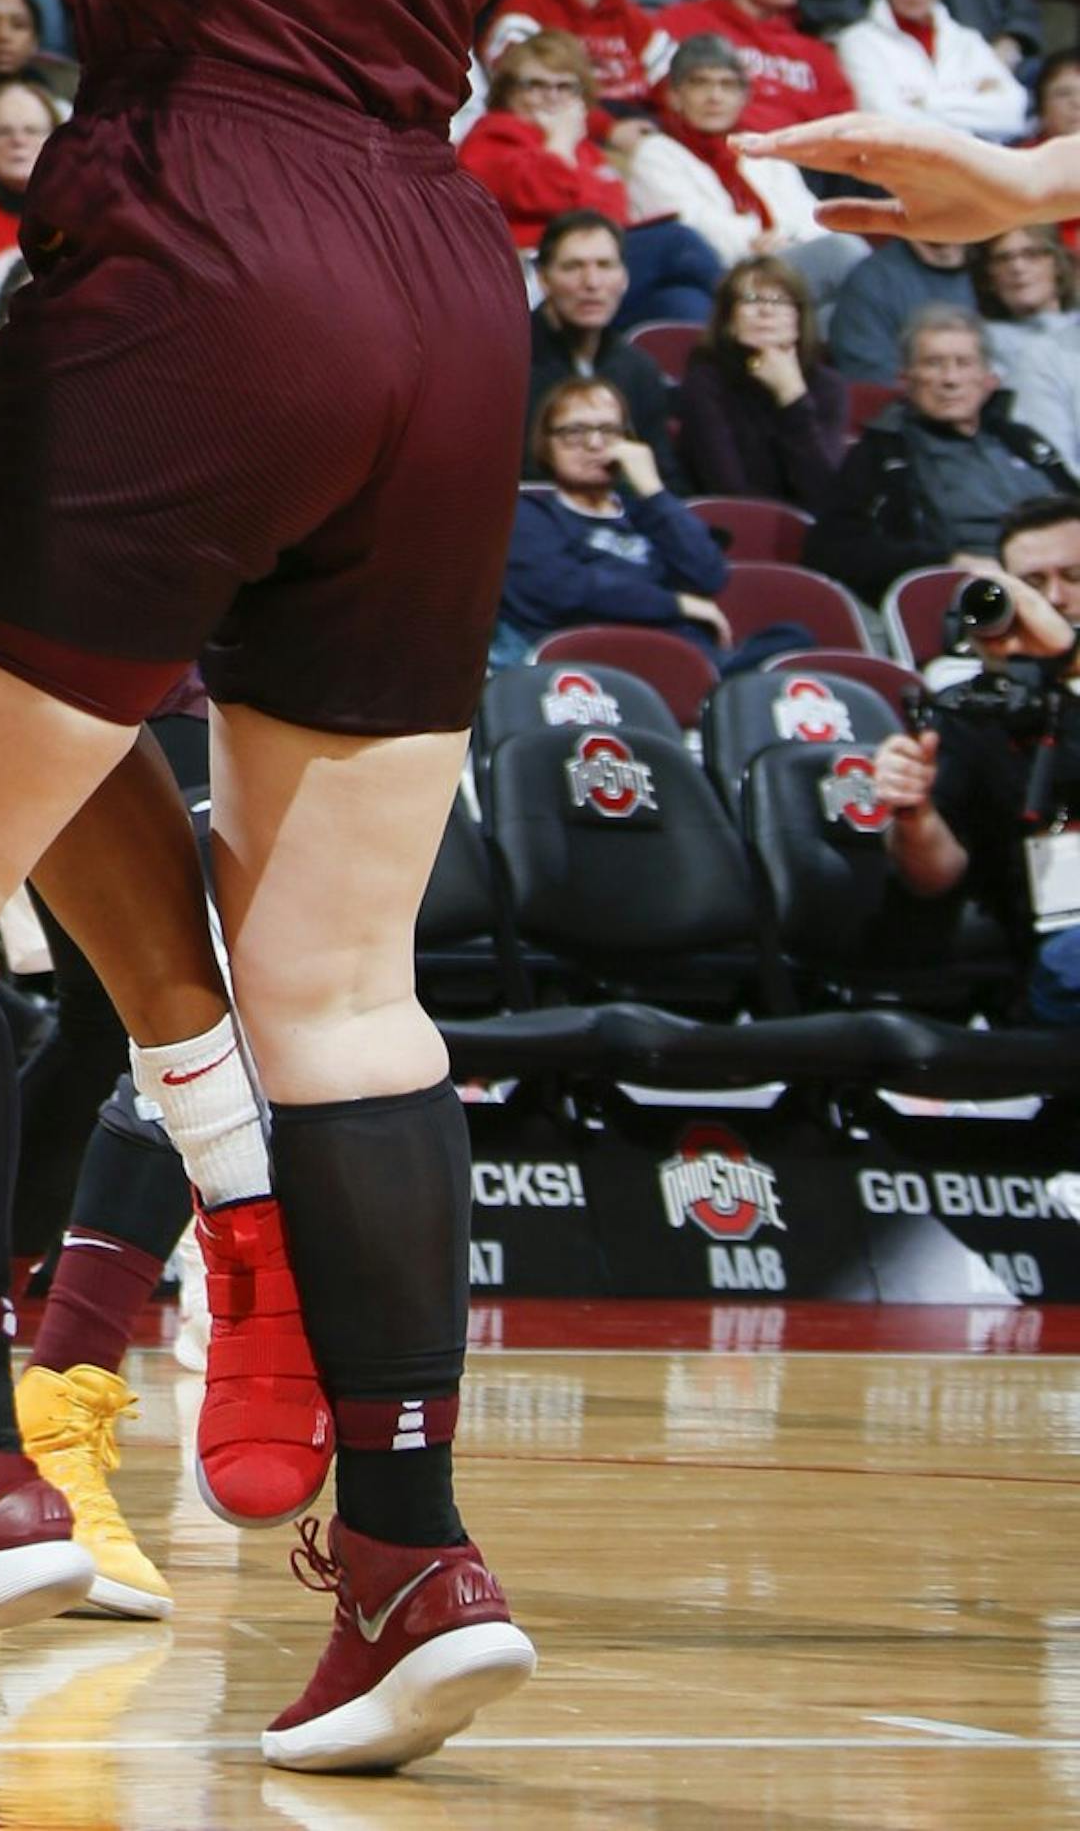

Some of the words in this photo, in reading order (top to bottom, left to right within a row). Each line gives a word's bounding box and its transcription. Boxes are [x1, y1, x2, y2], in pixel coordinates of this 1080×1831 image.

[471, 1162, 587, 1208] CKS!
[859, 1169, 931, 1215] GO
[707, 1245, 787, 1291] AA8
